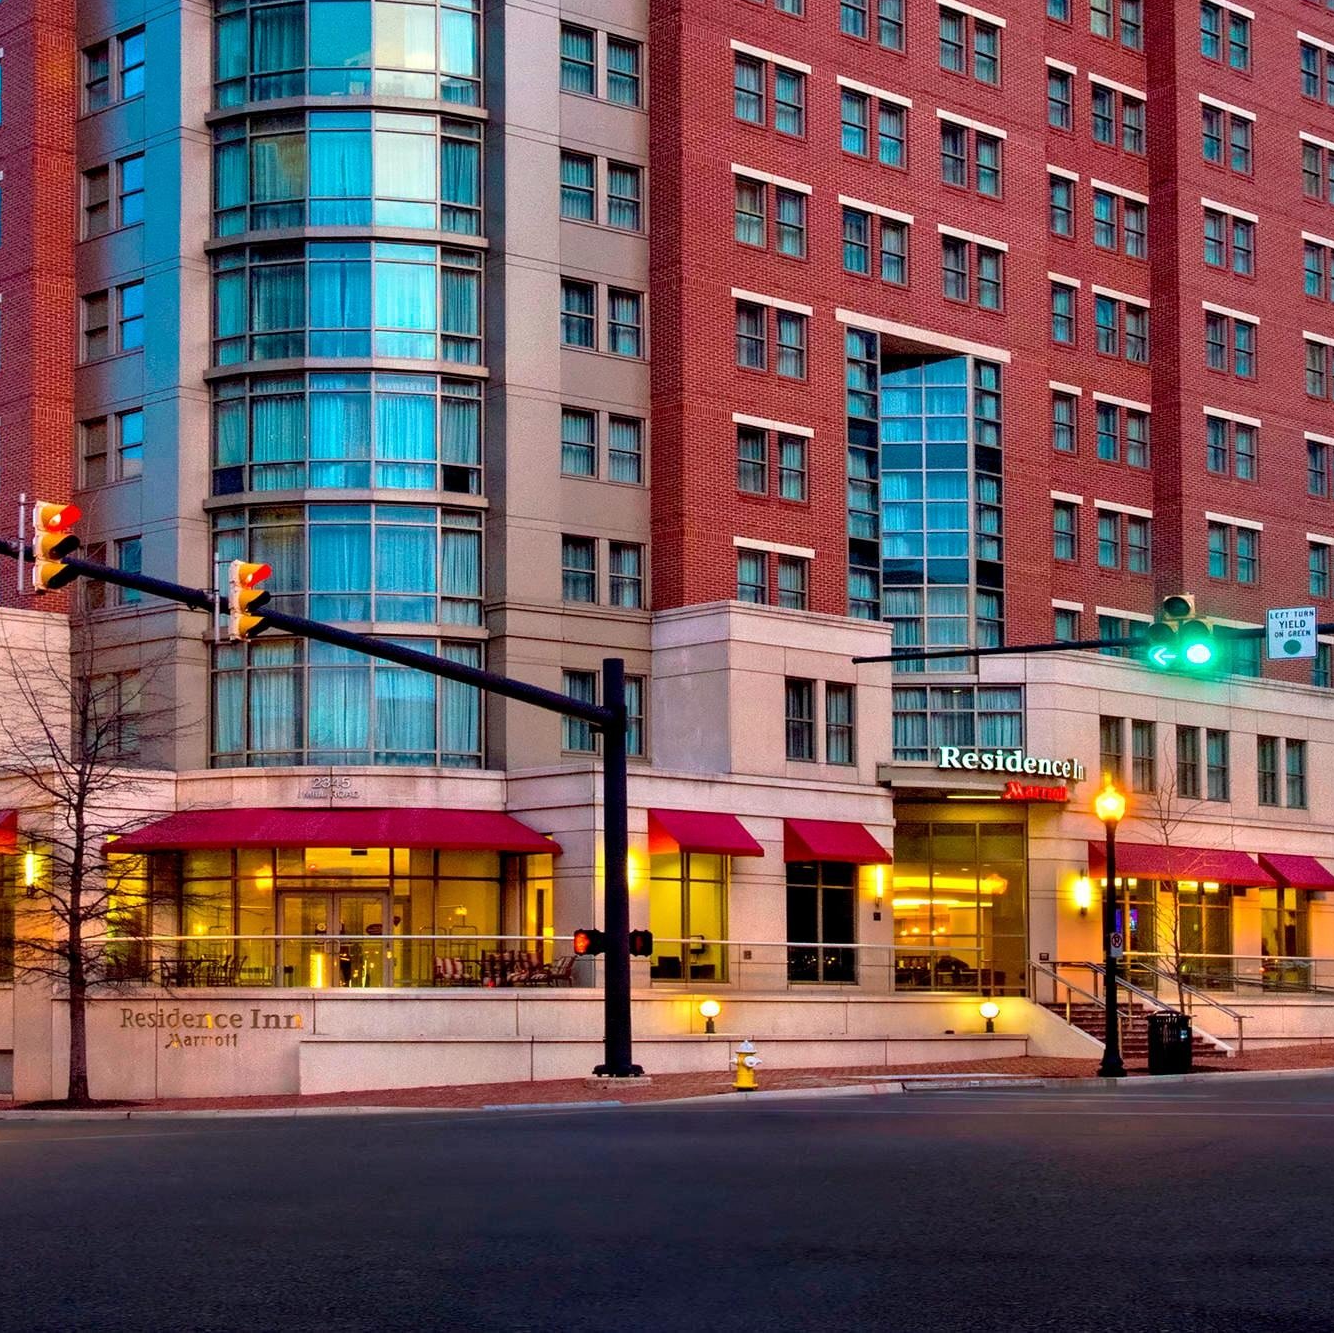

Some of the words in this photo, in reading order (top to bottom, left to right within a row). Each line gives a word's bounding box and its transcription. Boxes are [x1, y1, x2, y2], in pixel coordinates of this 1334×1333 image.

[1279, 620, 1306, 629] YIELD
[938, 746, 1070, 778] Residence
[312, 777, 351, 789] 2345
[120, 1008, 244, 1029] Residence
[250, 1009, 303, 1029] Inn
[165, 1033, 238, 1049] Marriott
